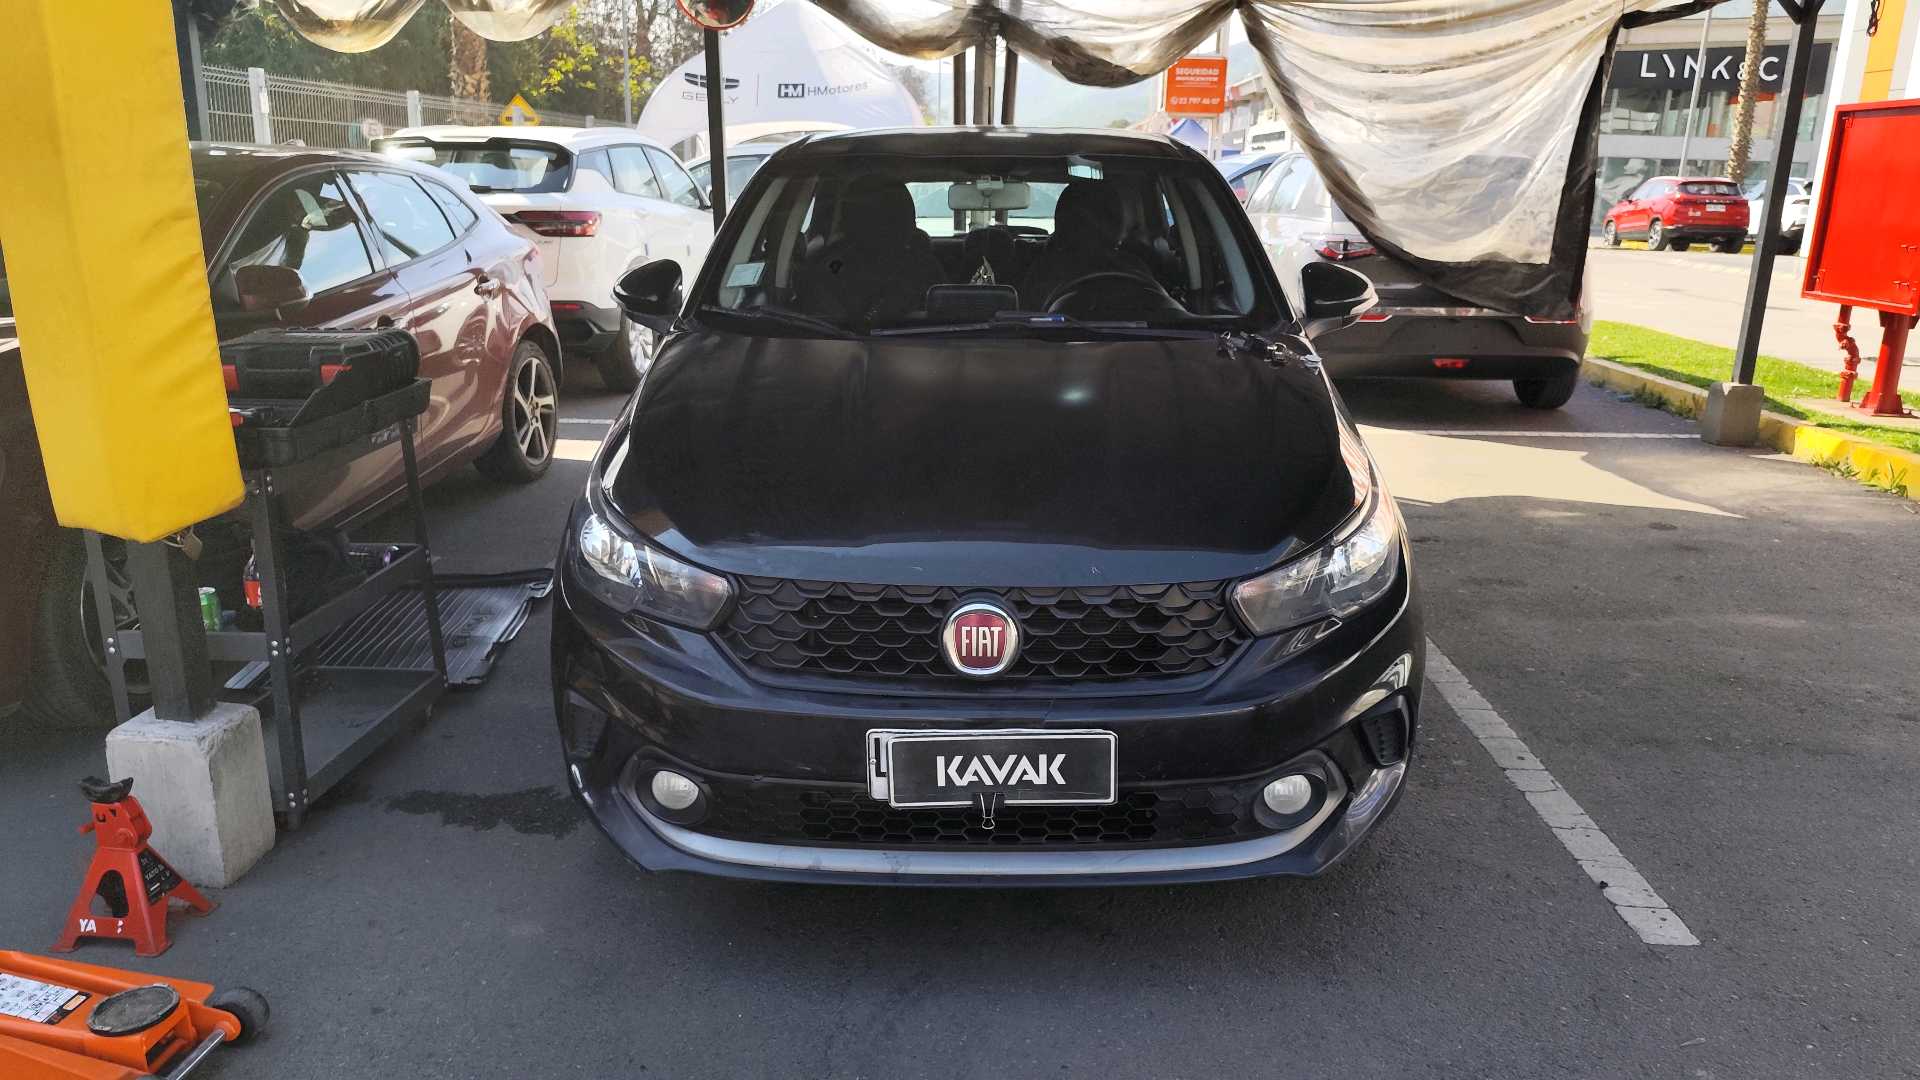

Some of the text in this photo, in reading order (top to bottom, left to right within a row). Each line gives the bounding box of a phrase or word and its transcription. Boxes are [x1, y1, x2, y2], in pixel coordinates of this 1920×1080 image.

[1175, 67, 1220, 75] SEGURIDAD
[1640, 53, 1780, 81] LYNK&C
[682, 91, 739, 104] GEY
[780, 82, 868, 97] HM HMotores
[961, 626, 1002, 657] FIAT
[936, 754, 1067, 786] KAVAK
